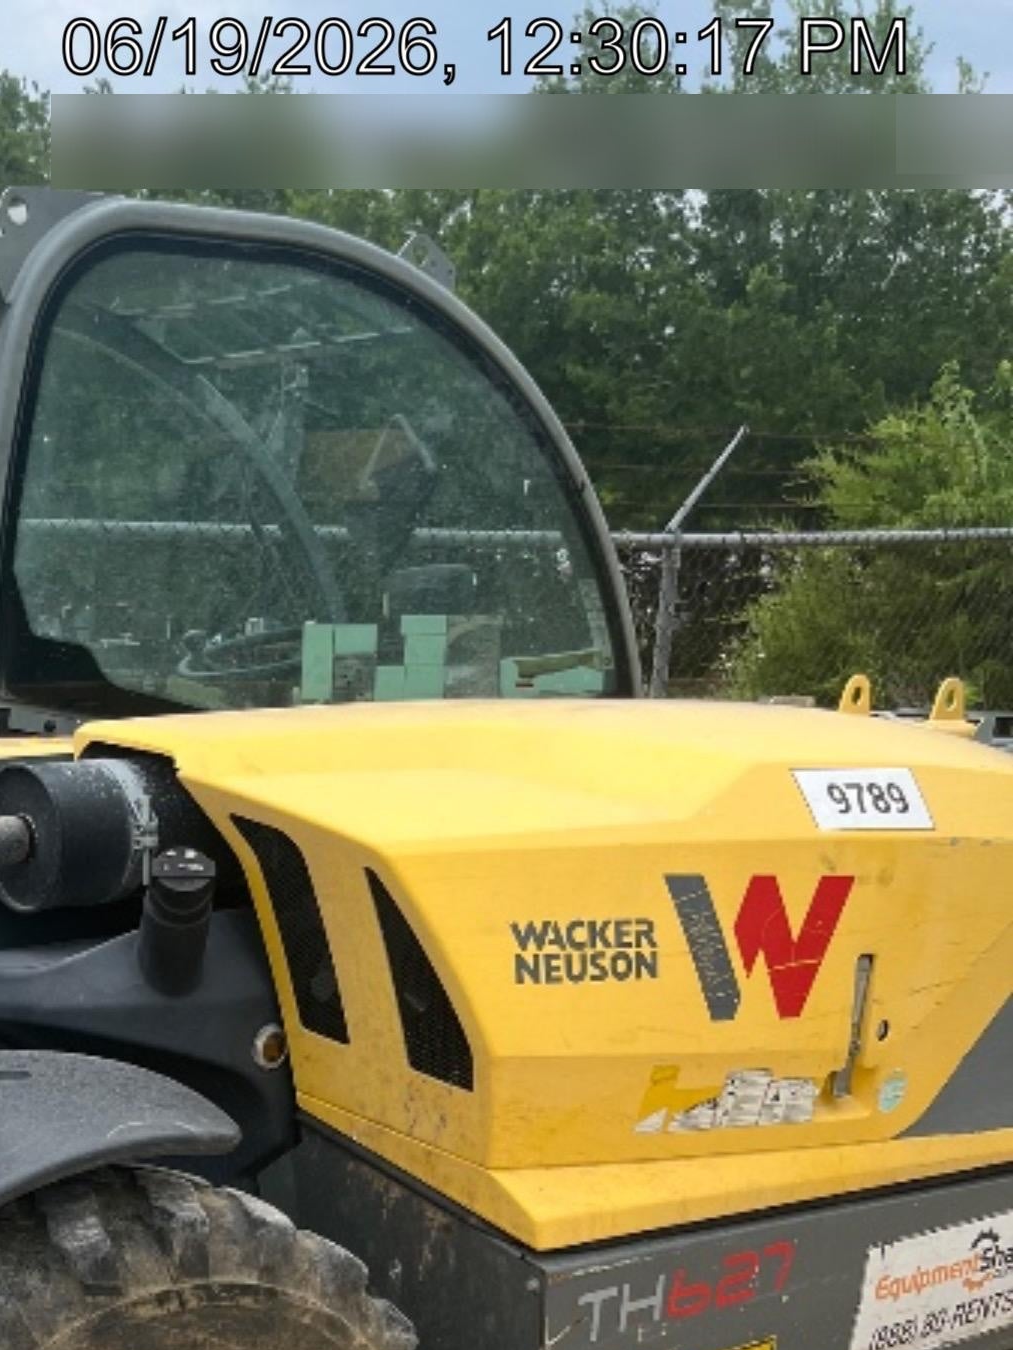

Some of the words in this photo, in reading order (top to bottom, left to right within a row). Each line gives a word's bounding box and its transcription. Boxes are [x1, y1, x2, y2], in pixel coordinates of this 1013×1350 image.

[826, 782, 910, 814] 9789
[510, 917, 657, 951] WACKER
[514, 950, 658, 985] NEUSON
